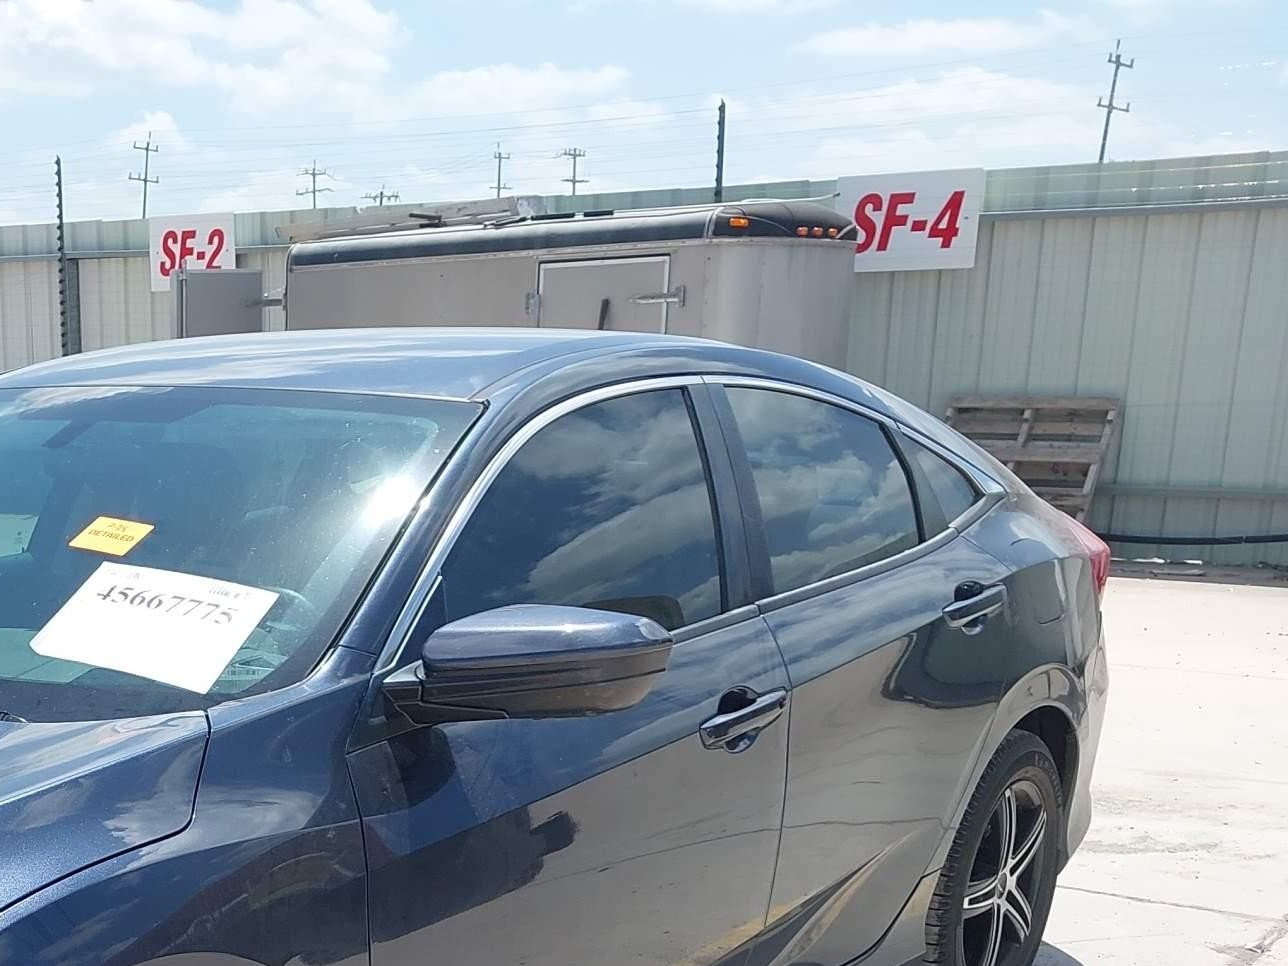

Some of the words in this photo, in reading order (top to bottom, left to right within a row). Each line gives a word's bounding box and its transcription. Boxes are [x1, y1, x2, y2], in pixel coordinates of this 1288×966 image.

[854, 190, 966, 254] SF-4
[159, 228, 225, 277] SF-2
[96, 584, 240, 625] 45667775
